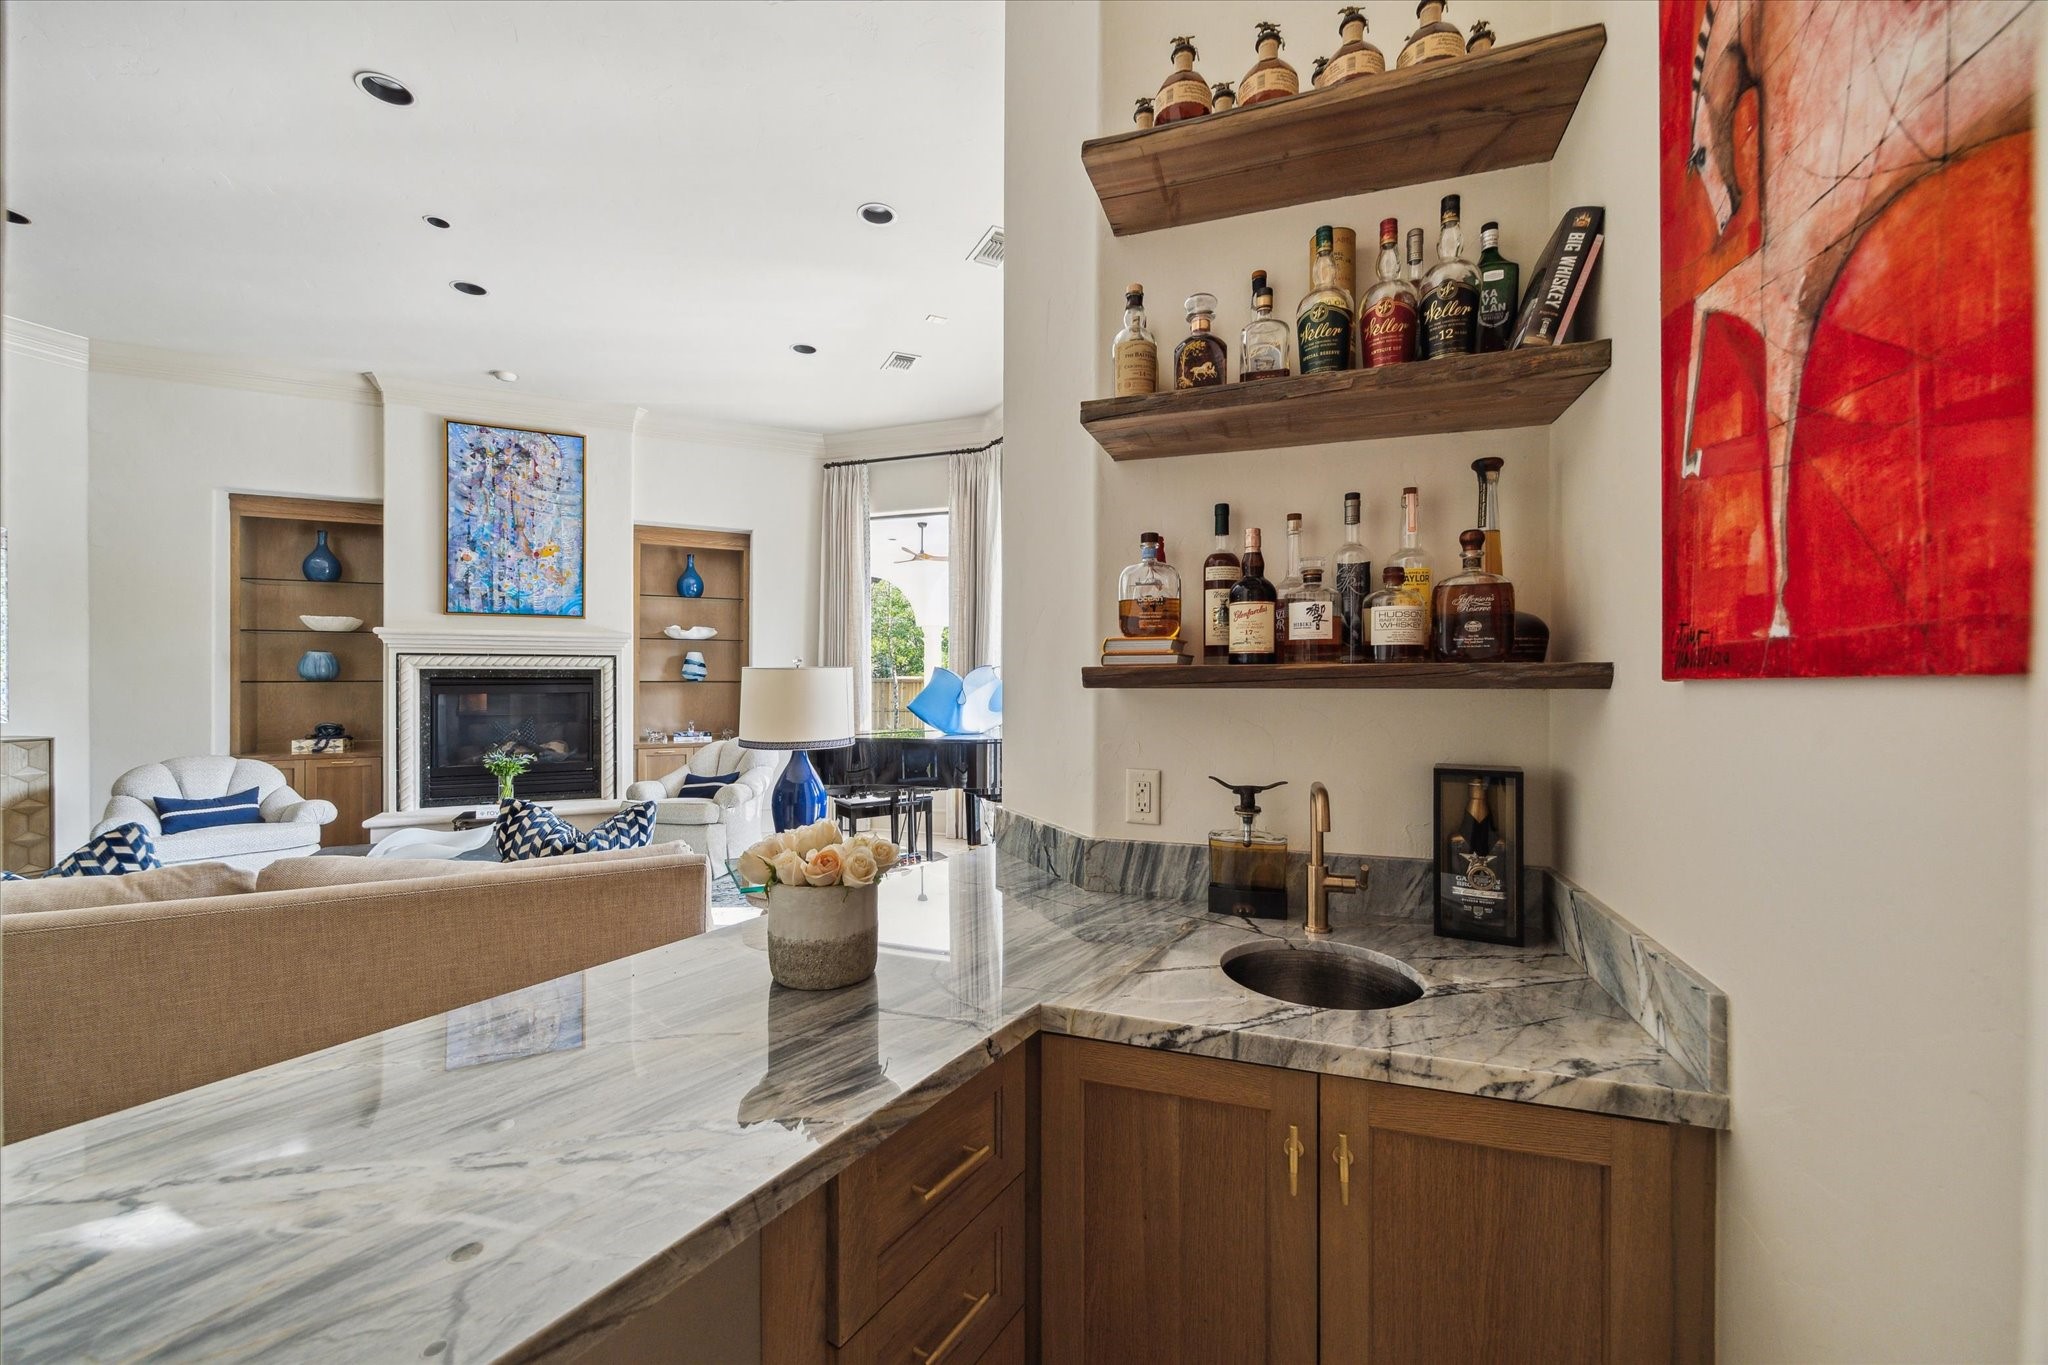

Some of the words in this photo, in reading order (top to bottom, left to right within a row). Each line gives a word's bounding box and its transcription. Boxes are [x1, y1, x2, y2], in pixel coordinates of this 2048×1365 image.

[1564, 232, 1586, 252] BIG
[1545, 256, 1578, 309] WHISKEY
[1424, 300, 1472, 325] Weller
[1300, 322, 1344, 345] Weller
[1364, 317, 1408, 340] Weller
[1438, 328, 1454, 341] 12
[1404, 574, 1430, 583] AYLOR
[1452, 593, 1495, 606] Jefferson's
[1456, 603, 1492, 613] Reserve
[1233, 605, 1268, 622] Glenfarclas
